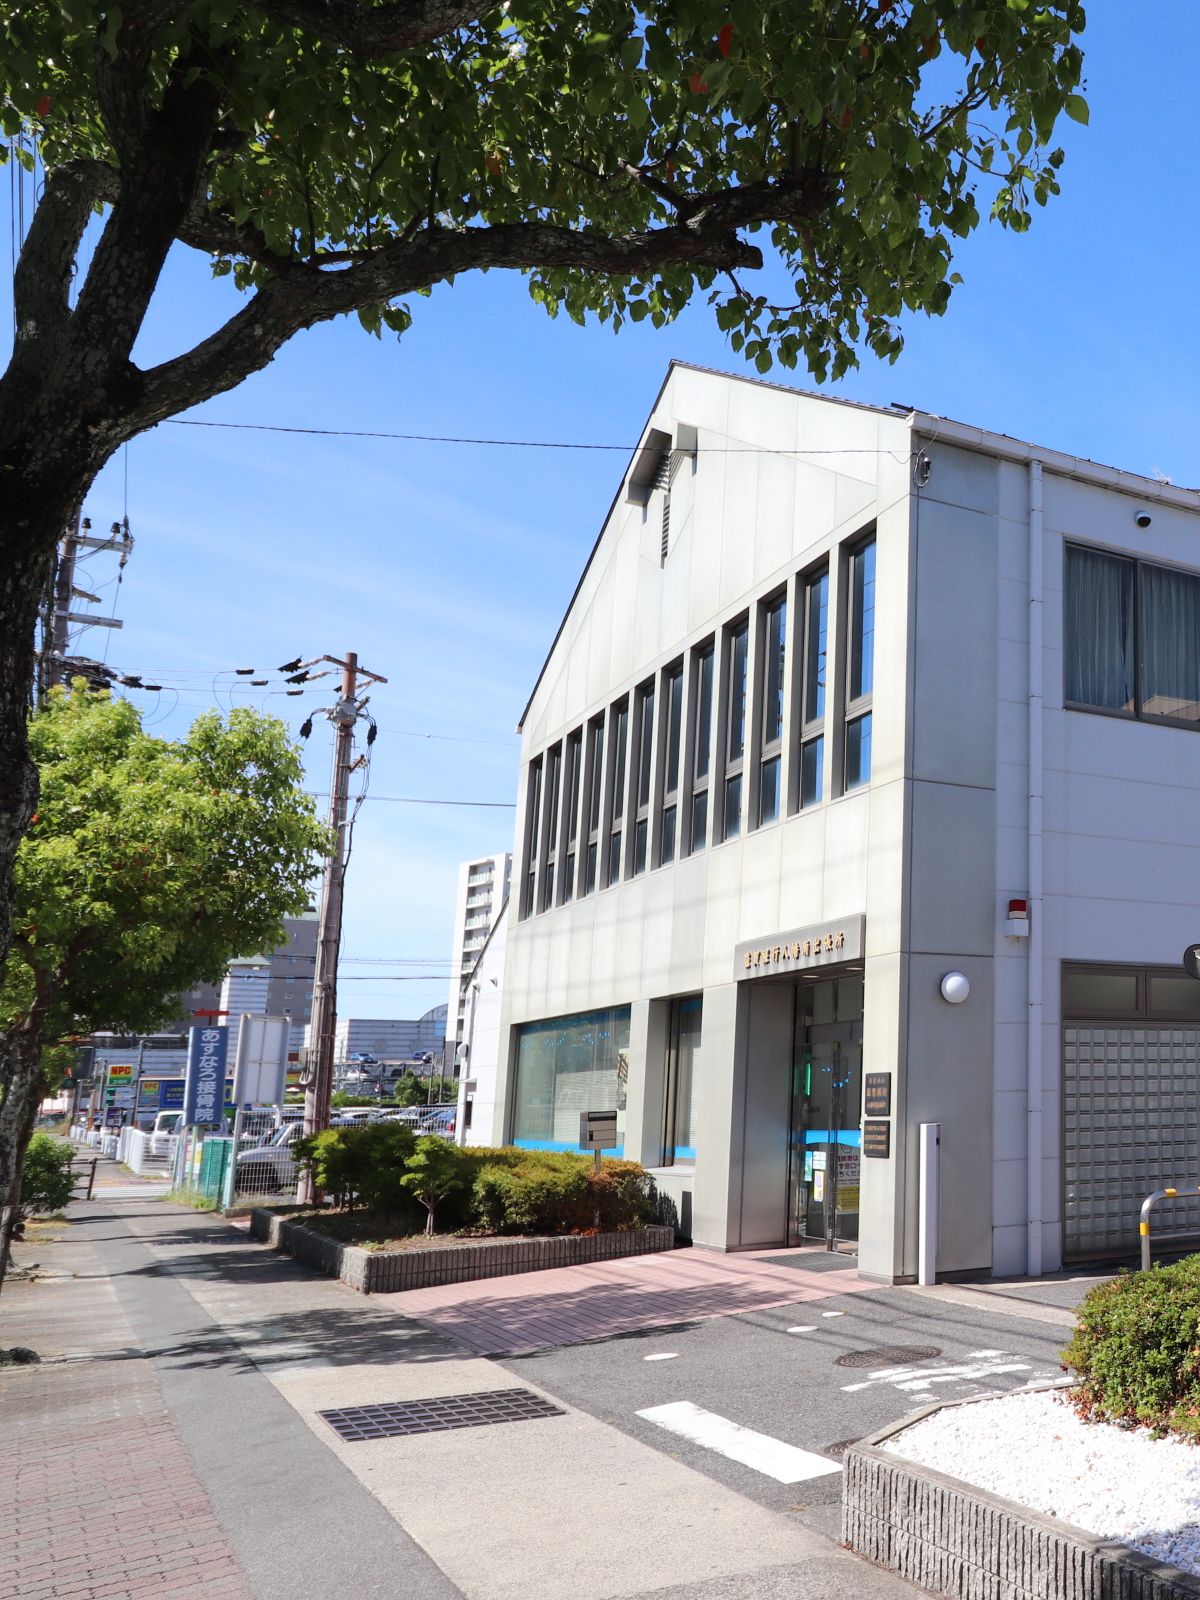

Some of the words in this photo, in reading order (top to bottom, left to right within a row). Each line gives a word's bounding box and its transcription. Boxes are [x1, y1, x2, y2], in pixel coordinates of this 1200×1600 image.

[110, 1066, 131, 1075] NPC
[195, 1029, 220, 1122] あすなろ接骨院
